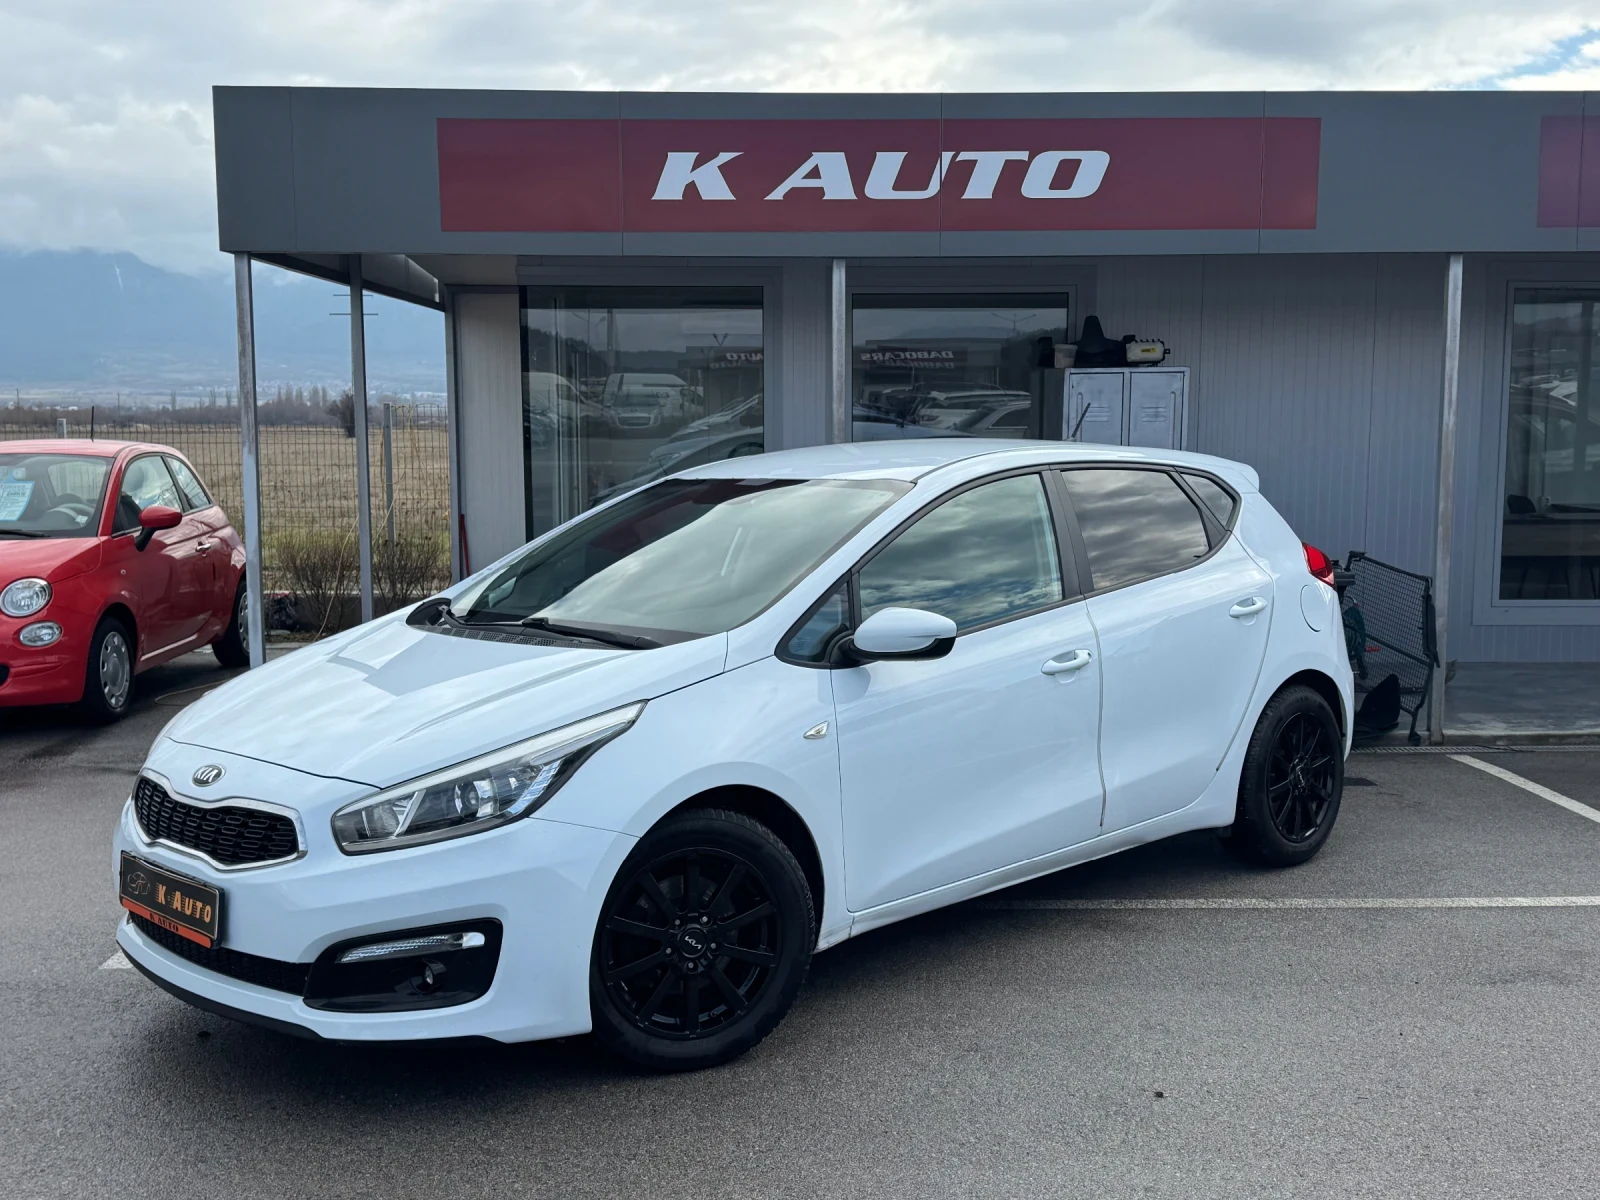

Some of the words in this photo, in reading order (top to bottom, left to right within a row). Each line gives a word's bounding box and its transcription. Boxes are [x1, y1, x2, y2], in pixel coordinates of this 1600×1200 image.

[651, 152, 743, 201] K
[764, 150, 1110, 201] AUTO
[194, 766, 219, 783] KIA
[156, 883, 167, 905] K
[171, 890, 212, 923] AUTO
[149, 912, 156, 922] K
[157, 916, 179, 933] AUTO
